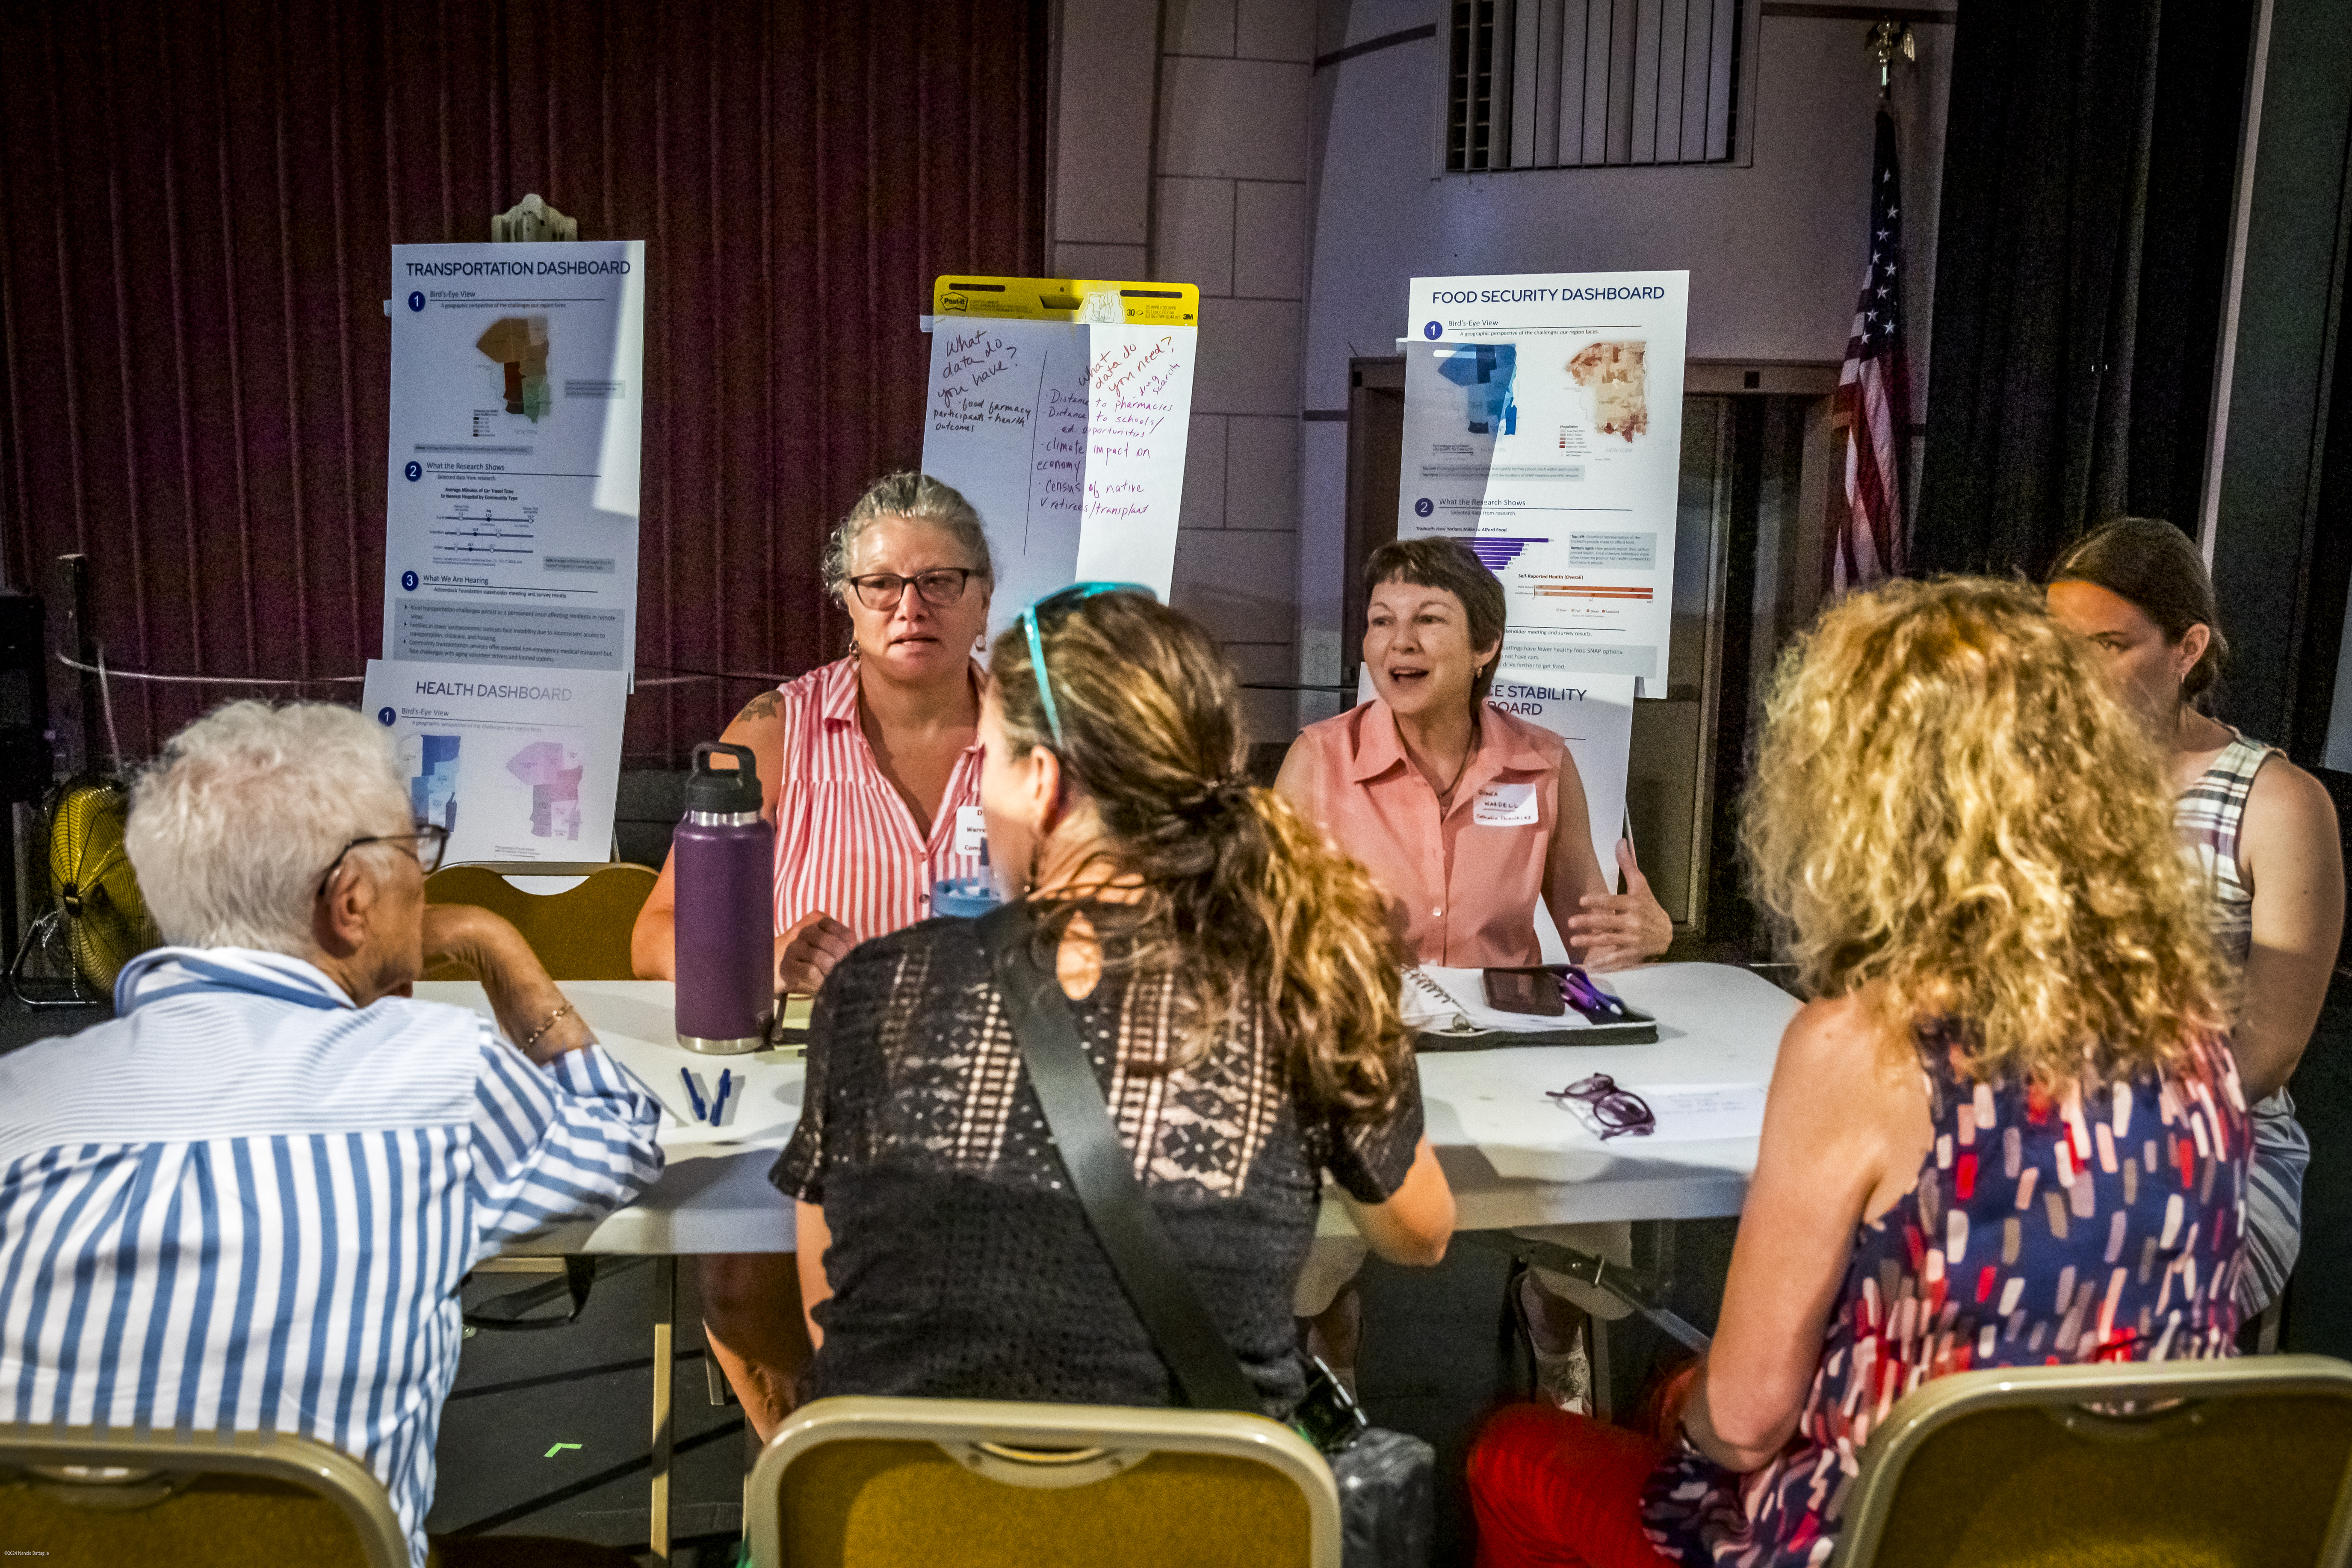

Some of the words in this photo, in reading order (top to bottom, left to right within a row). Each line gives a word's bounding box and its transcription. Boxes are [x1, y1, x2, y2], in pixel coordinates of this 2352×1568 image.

[405, 262, 533, 276] TRANSPORTATION
[538, 261, 631, 275] DASHBOARD
[414, 295, 419, 307] 1
[429, 290, 458, 299] Bird's-Eye
[1433, 290, 1477, 304] FOOD
[1481, 289, 1558, 303] SECURITY
[1562, 286, 1665, 301] DASHBOARD
[1430, 325, 1436, 336] 1
[1448, 319, 1480, 328] Bird's-Eye
[947, 330, 987, 357] What
[943, 356, 984, 378] data
[985, 339, 1002, 357] do
[1096, 361, 1123, 389] data
[1123, 344, 1136, 358] do
[1108, 372, 1135, 397] you
[1140, 375, 1159, 396] drug
[1152, 363, 1180, 395] scarcity
[938, 386, 969, 408] you
[1050, 389, 1089, 406] Distance
[1096, 397, 1107, 407] to
[1115, 396, 1173, 412] pharmacies
[963, 398, 984, 410] food
[989, 402, 1031, 420] farmacy
[1049, 407, 1087, 419] Distance
[1096, 411, 1108, 422] to
[995, 413, 1025, 427] health
[1082, 427, 1145, 437] opportunities
[1094, 442, 1129, 465] impact
[1137, 448, 1150, 458] on
[409, 465, 417, 477] 2
[456, 461, 483, 470] Research
[1037, 460, 1081, 481] economy
[1088, 481, 1099, 498] of
[1106, 479, 1144, 493] native
[1420, 502, 1428, 513] 2
[406, 574, 413, 586] 3
[464, 575, 488, 585] Hearing
[417, 682, 473, 697] HEALTH
[478, 685, 573, 701] DASHBOARD
[1507, 685, 1587, 701] STABILITY
[384, 711, 389, 722] 1
[402, 706, 431, 717] Bird's-Eye
